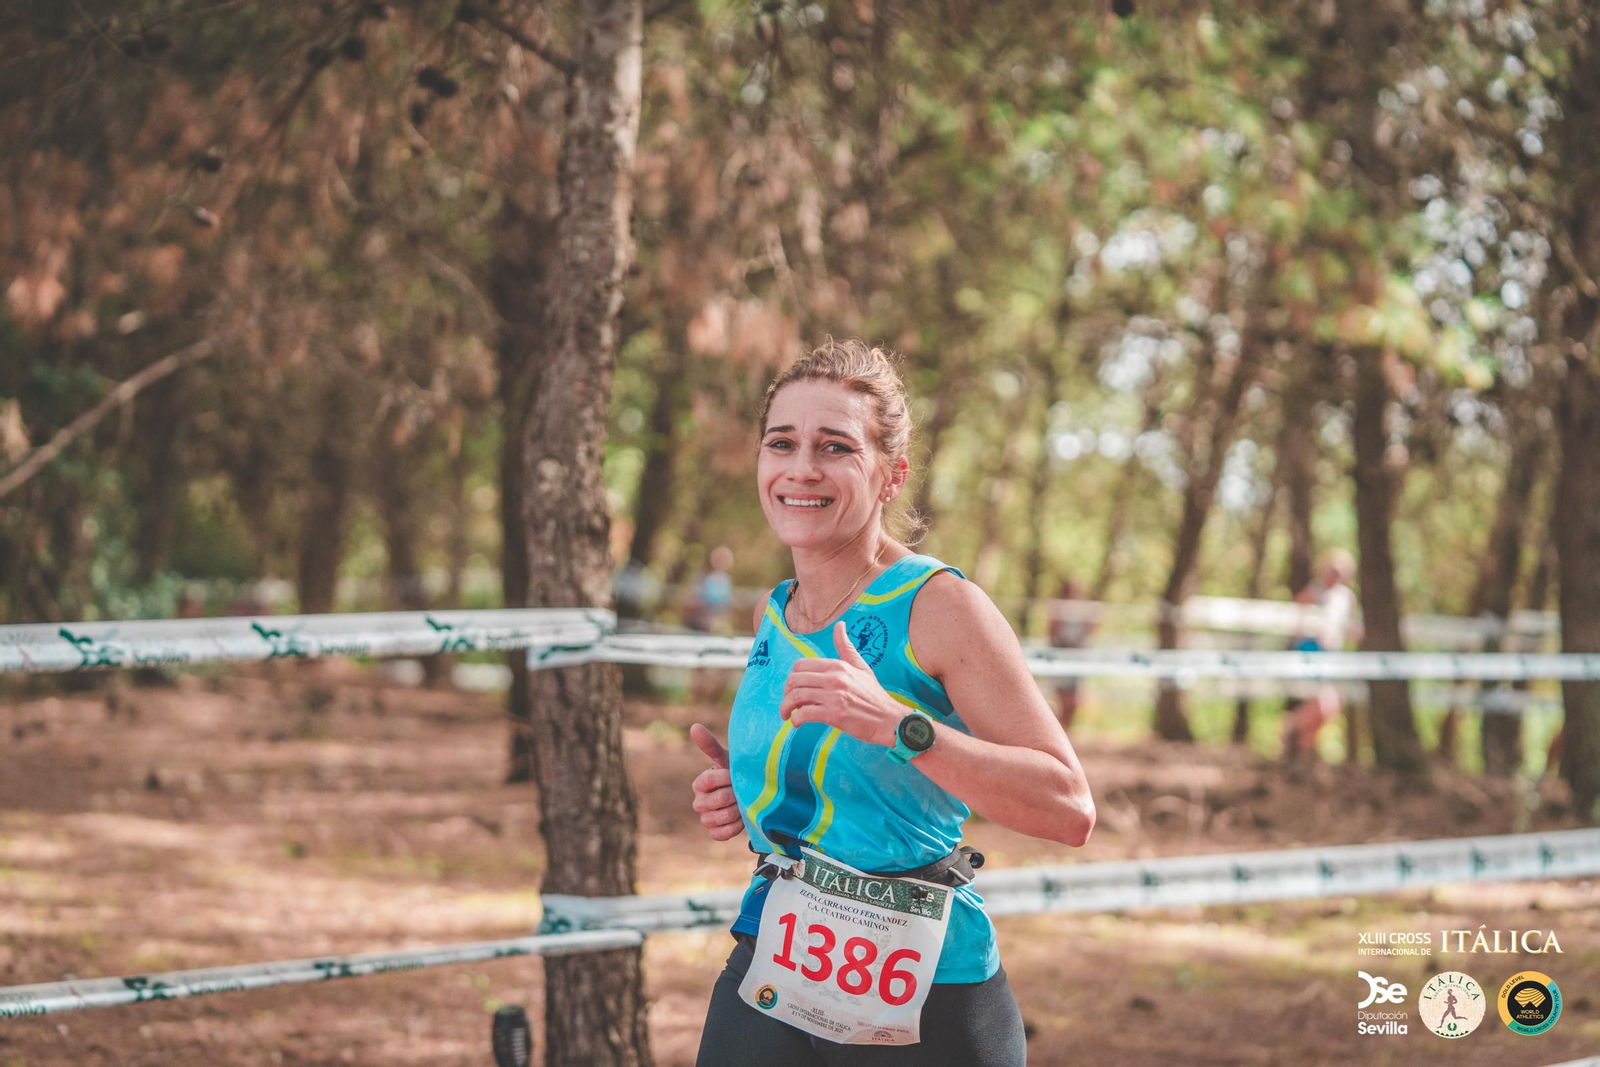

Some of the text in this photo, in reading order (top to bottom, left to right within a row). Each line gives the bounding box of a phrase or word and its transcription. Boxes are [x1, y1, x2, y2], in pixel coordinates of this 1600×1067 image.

[813, 865, 896, 904] ITÁLICA
[799, 888, 908, 928] ELENA CARRASCO FERNANDEZ
[807, 902, 890, 932] C.A. CUATRO CAMINOS
[773, 912, 922, 1006] 1386
